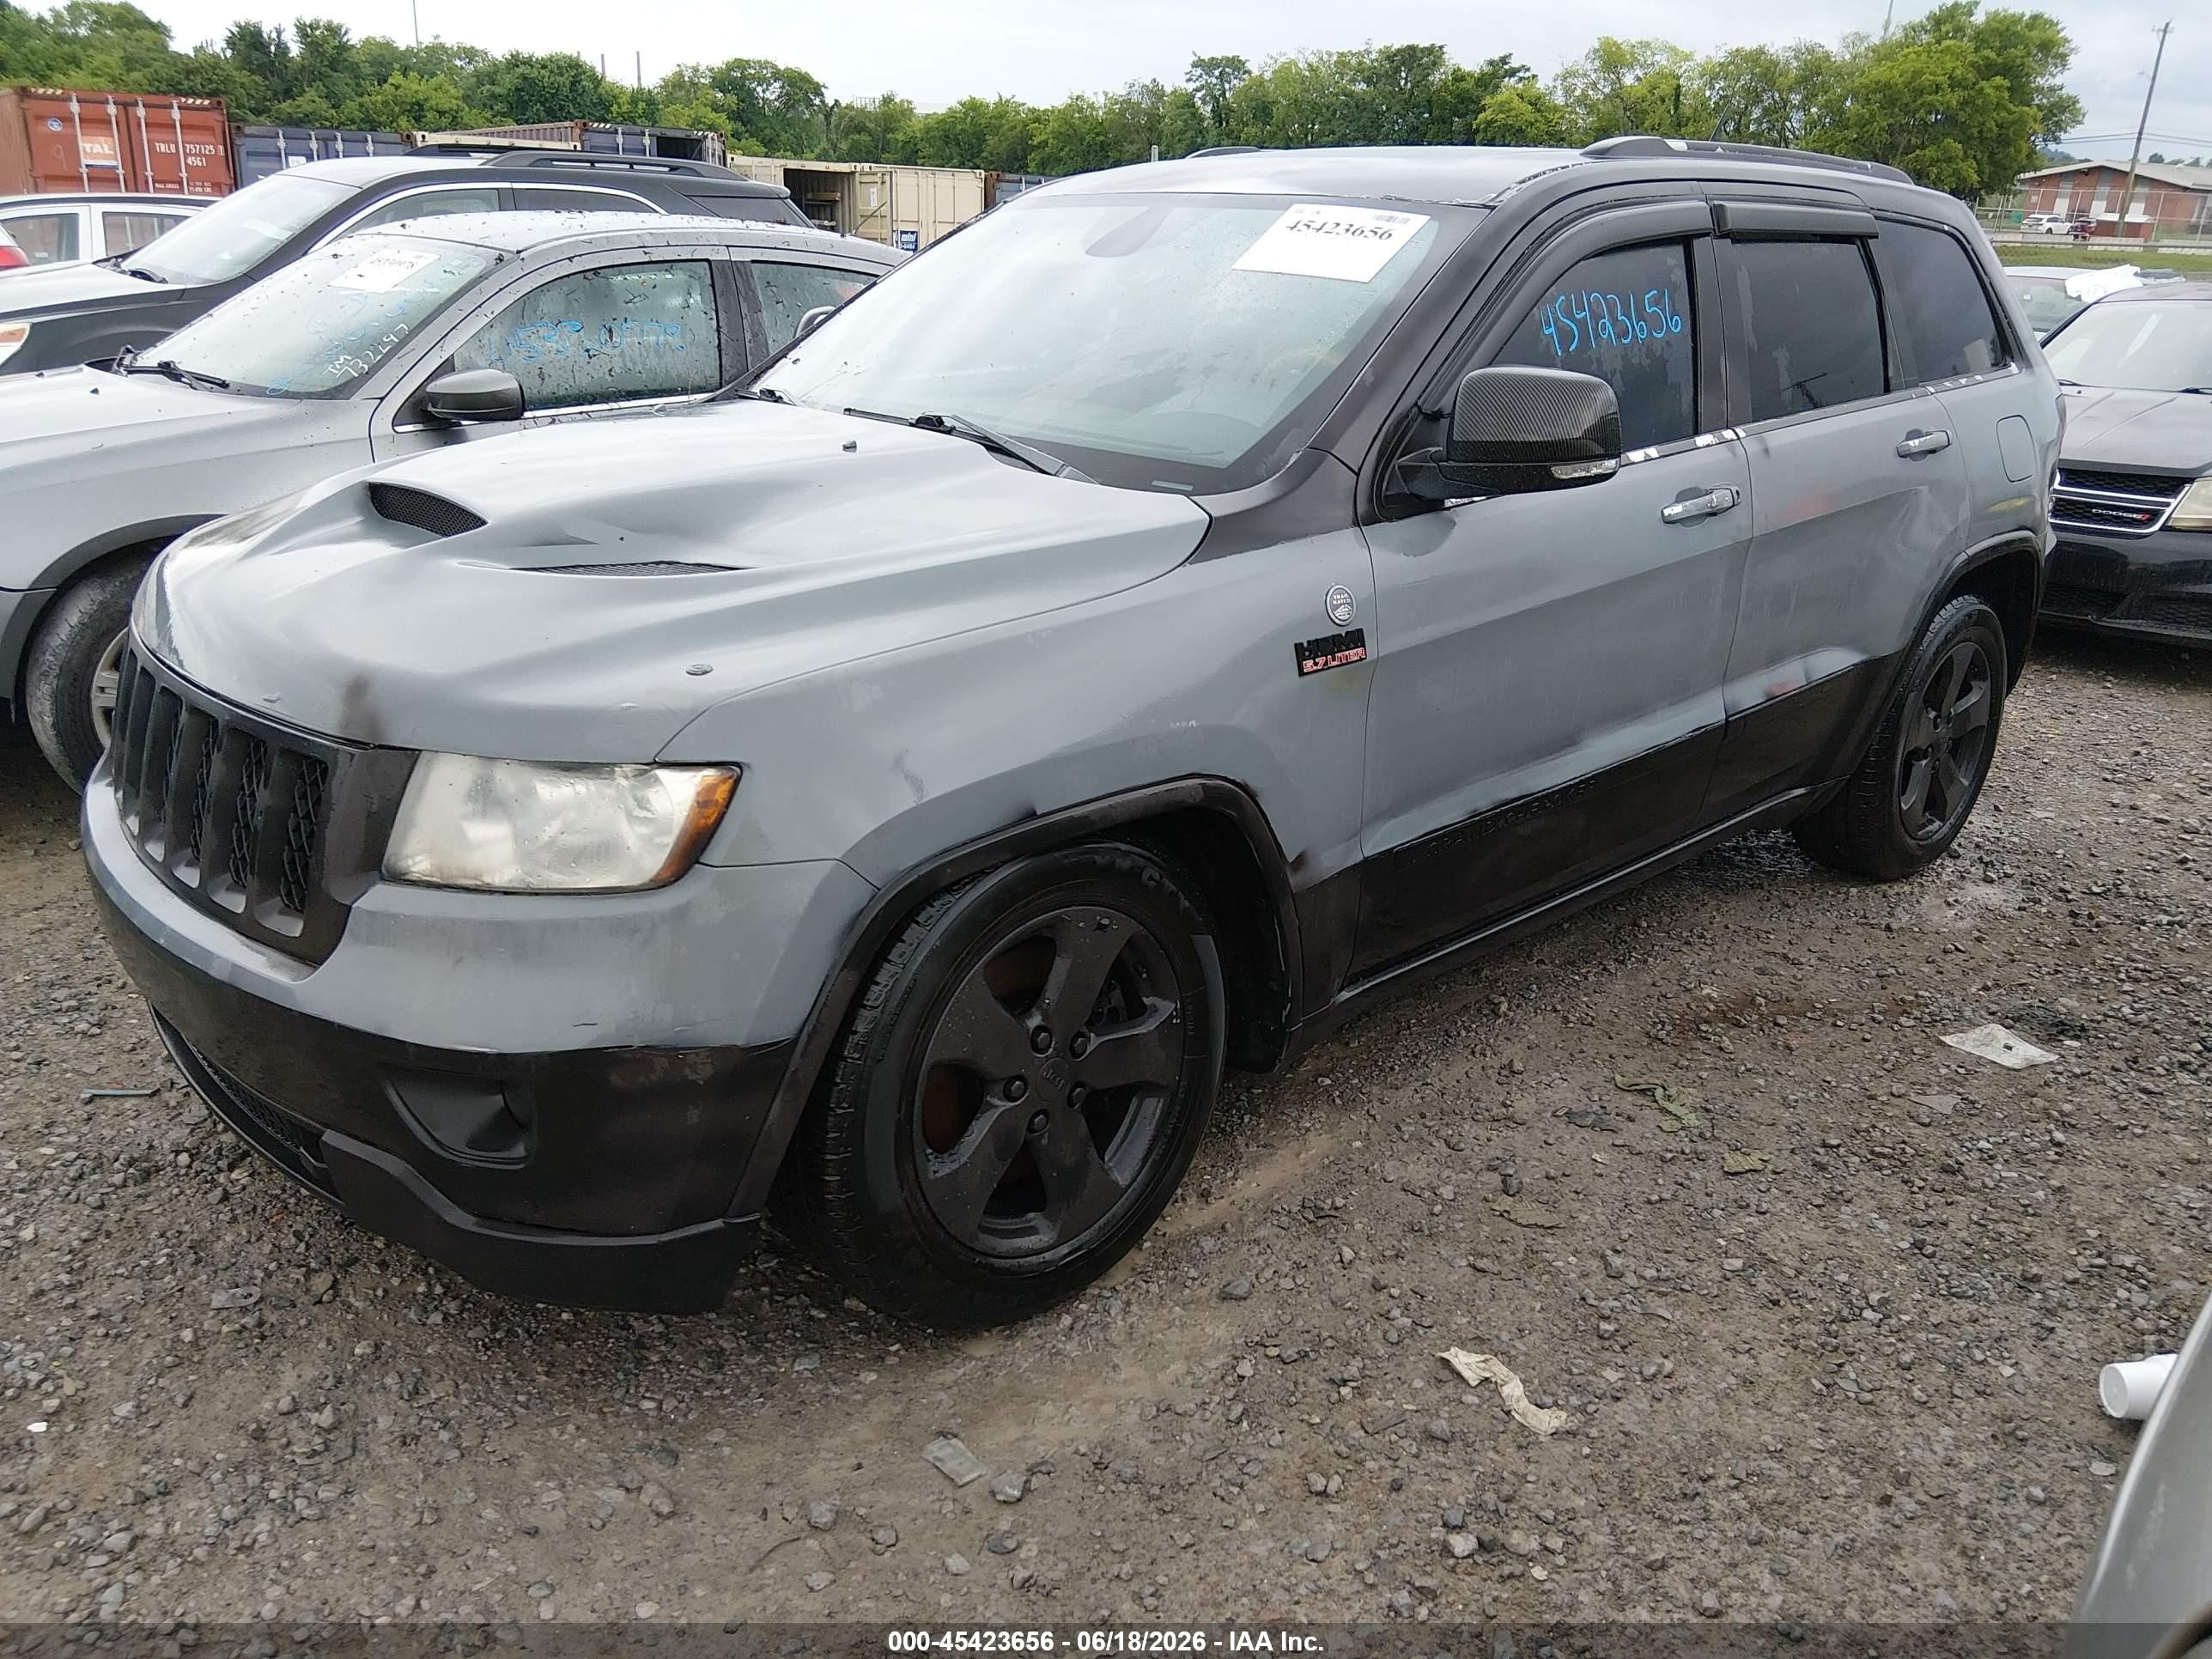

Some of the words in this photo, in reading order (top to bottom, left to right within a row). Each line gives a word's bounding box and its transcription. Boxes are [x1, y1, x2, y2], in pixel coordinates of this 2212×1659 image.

[82, 143, 114, 155] TAL
[155, 142, 177, 155] TRLU
[185, 143, 216, 155] 757125
[186, 156, 208, 167] 4561
[1285, 220, 1394, 241] 45423656
[1540, 288, 1682, 357] 45423656
[1303, 656, 1327, 672] 5.7
[1328, 647, 1366, 666] LITER
